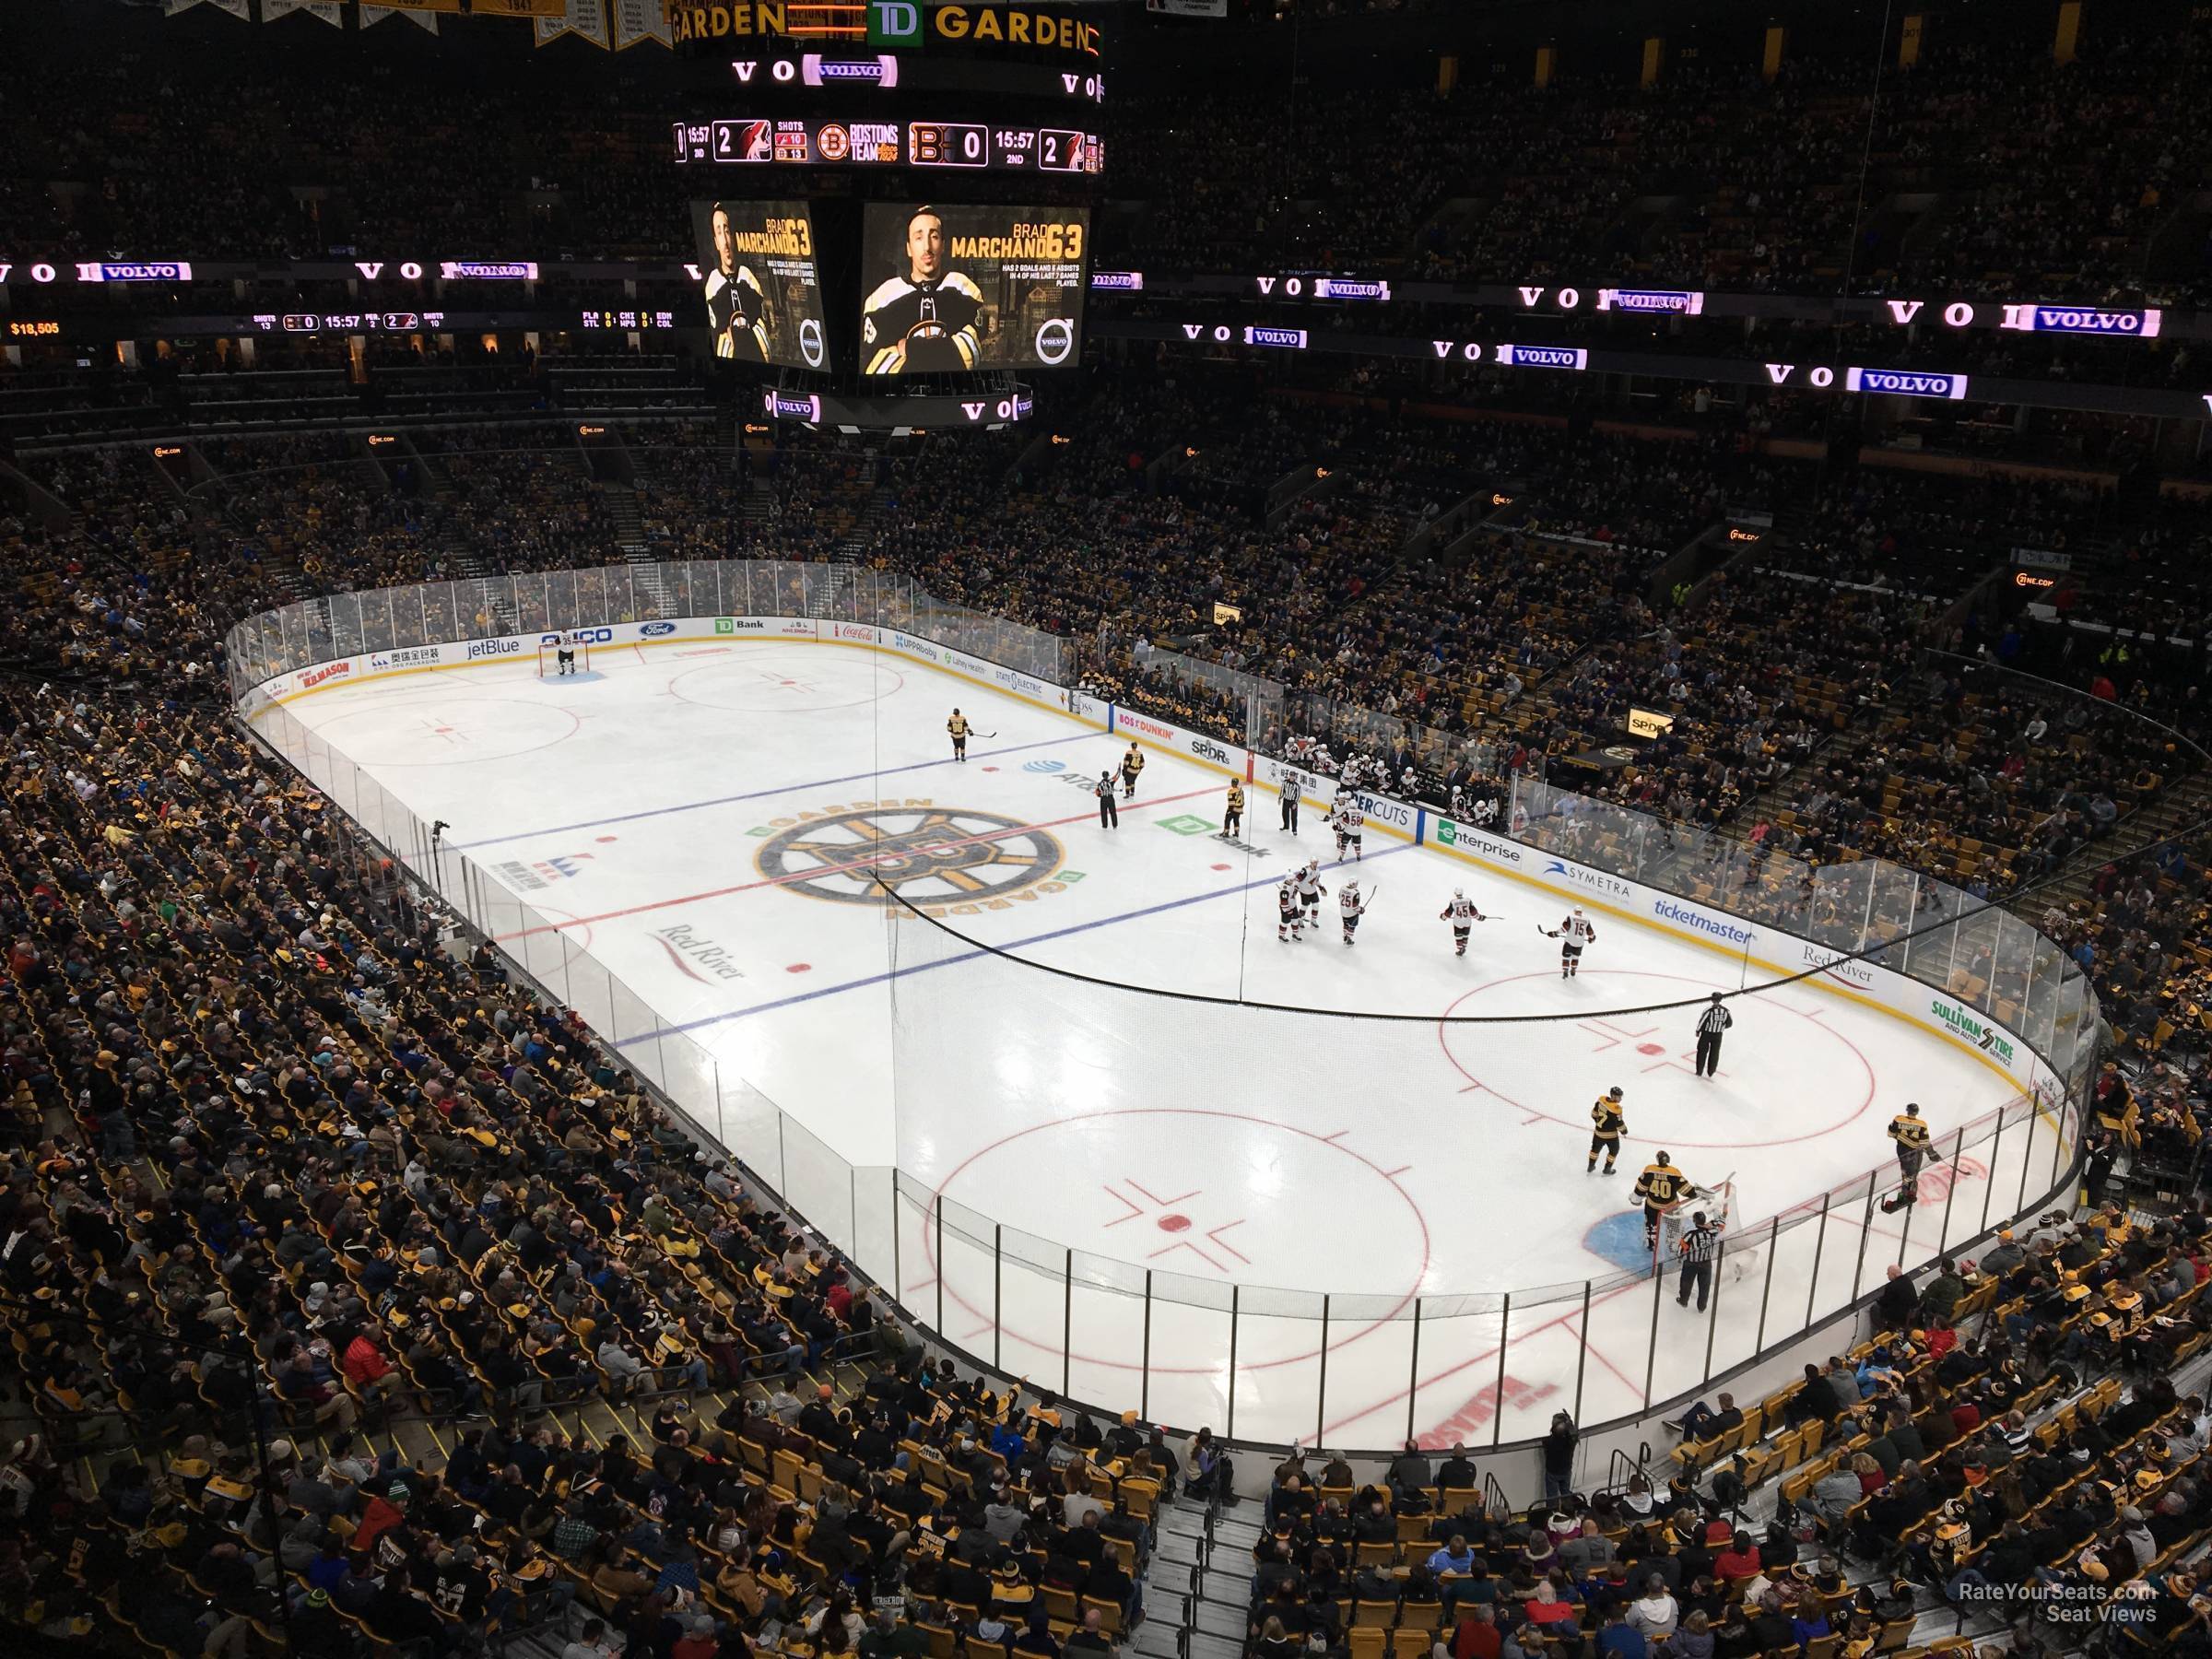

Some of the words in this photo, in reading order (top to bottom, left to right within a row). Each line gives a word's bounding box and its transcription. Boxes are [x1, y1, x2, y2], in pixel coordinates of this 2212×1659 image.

[672, 4, 786, 43] GARDEN
[873, 1, 917, 36] TD
[935, 6, 1090, 50] GARDEN
[777, 121, 804, 132] SHOTS
[688, 127, 709, 143] 15:57
[719, 127, 731, 152] 2
[791, 135, 801, 144] 10
[995, 131, 1034, 149] 15:57
[851, 143, 877, 161] TEAM
[964, 132, 980, 158] 0
[1045, 137, 1056, 162] 2
[791, 150, 802, 159] 13
[1006, 155, 1024, 165] 2ND
[736, 232, 789, 253] MARCHAND
[766, 218, 786, 233] BRAD
[786, 218, 811, 255] 63
[1014, 224, 1047, 238] BRAD
[1046, 224, 1083, 259] 63
[951, 237, 1047, 258] MARCHAND
[104, 265, 177, 278] VOLVO
[1002, 264, 1014, 272] HAS
[1056, 279, 1078, 288] PLAYED.
[253, 314, 276, 323] SHOTS
[305, 316, 313, 328] 0
[325, 316, 359, 328] 15:57
[389, 315, 397, 327] 2
[423, 312, 444, 321] SHOTS
[582, 312, 599, 320] FLA
[605, 312, 611, 320] 0
[619, 312, 635, 320] CHI
[641, 312, 648, 320] 0
[656, 312, 673, 320] EDM
[2040, 311, 2139, 331] VOLVO
[11, 323, 59, 336] $18,505
[430, 320, 440, 328] 10
[582, 320, 600, 328] STL
[606, 320, 611, 328] 0
[619, 320, 636, 328] WPG
[642, 320, 648, 328] 0
[656, 320, 673, 328] COL
[803, 338, 819, 347] VOLVO
[1041, 337, 1067, 347] VOLVO
[1254, 330, 1298, 345] VOLVO
[1515, 349, 1574, 365] VOLVO
[1865, 373, 1948, 394] VOLVO
[777, 401, 811, 414] VOLVO
[646, 623, 668, 635] Ford
[716, 619, 732, 631] TD
[736, 620, 764, 629] Bank
[541, 628, 612, 646] GICO
[563, 637, 571, 646] 35
[467, 640, 519, 660] jetBlue
[406, 658, 441, 667] PACKAGING
[952, 656, 967, 669] Lahey
[968, 662, 985, 675] Health
[995, 670, 1011, 684] STATE
[1018, 677, 1042, 693] ELECTRIC
[1120, 713, 1135, 727] BOS
[1053, 771, 1098, 792] AT&
[1280, 769, 1317, 789] 旺集团
[1350, 815, 1361, 827] 58
[1441, 824, 1520, 863] enterprise
[1570, 866, 1630, 898] SYMETRA
[1341, 894, 1351, 908] 25
[1455, 905, 1468, 918] 45
[1574, 923, 1584, 936] 15
[1654, 900, 1751, 946] ticketmaster
[659, 924, 698, 950] Red
[693, 947, 746, 981] River
[1804, 945, 1832, 968] Red
[1834, 957, 1874, 982] River
[1931, 1001, 1983, 1039] SULLIVAN
[1994, 1035, 2015, 1061] TIRE
[1945, 1022, 1959, 1034] AND
[1960, 1030, 1978, 1044] AUTO
[1989, 1048, 2011, 1069] SERVICE
[1649, 1179, 1672, 1199] 40
